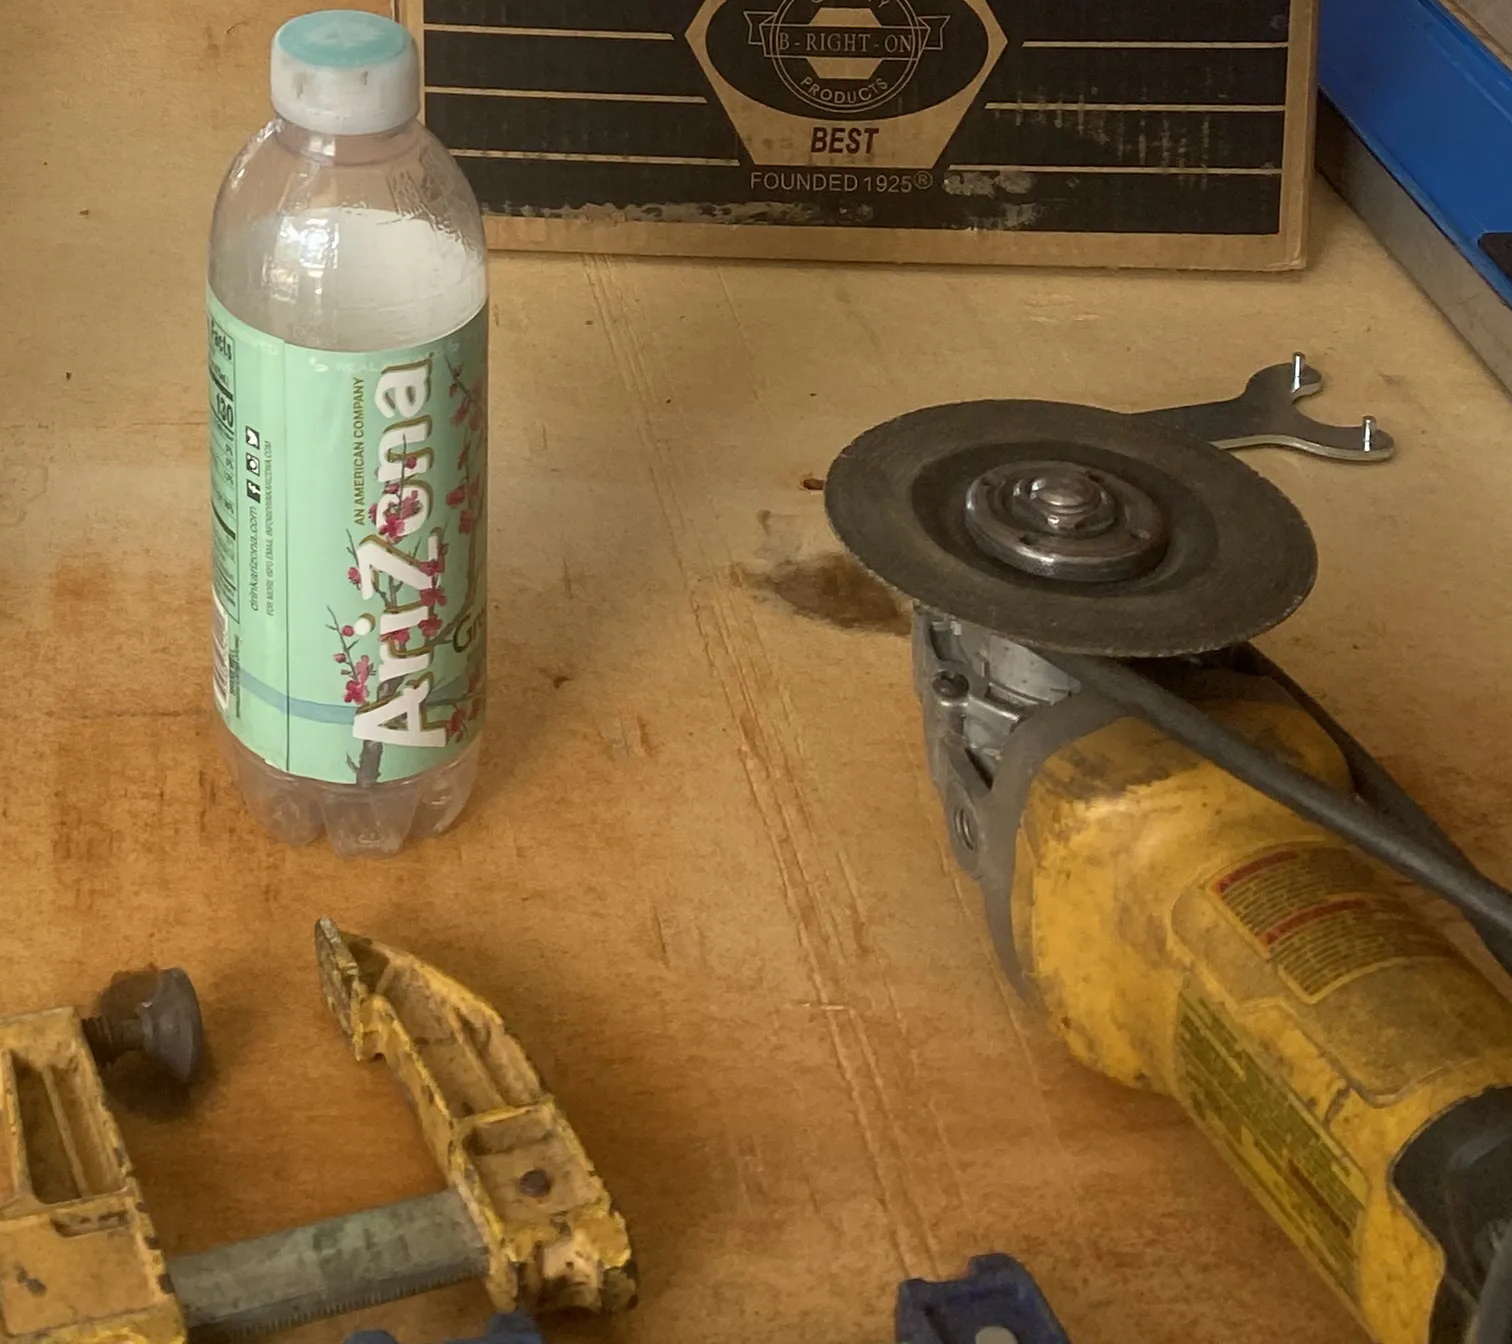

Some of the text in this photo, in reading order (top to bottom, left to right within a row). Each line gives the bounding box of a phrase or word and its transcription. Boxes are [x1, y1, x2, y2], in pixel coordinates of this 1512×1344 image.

[800, 76, 888, 104] PRODUCTS
[811, 127, 879, 154] BEST
[750, 172, 858, 191] FOUNDED
[352, 377, 365, 525] AN AMERICAN COMPANY
[352, 352, 448, 748] AriZona
